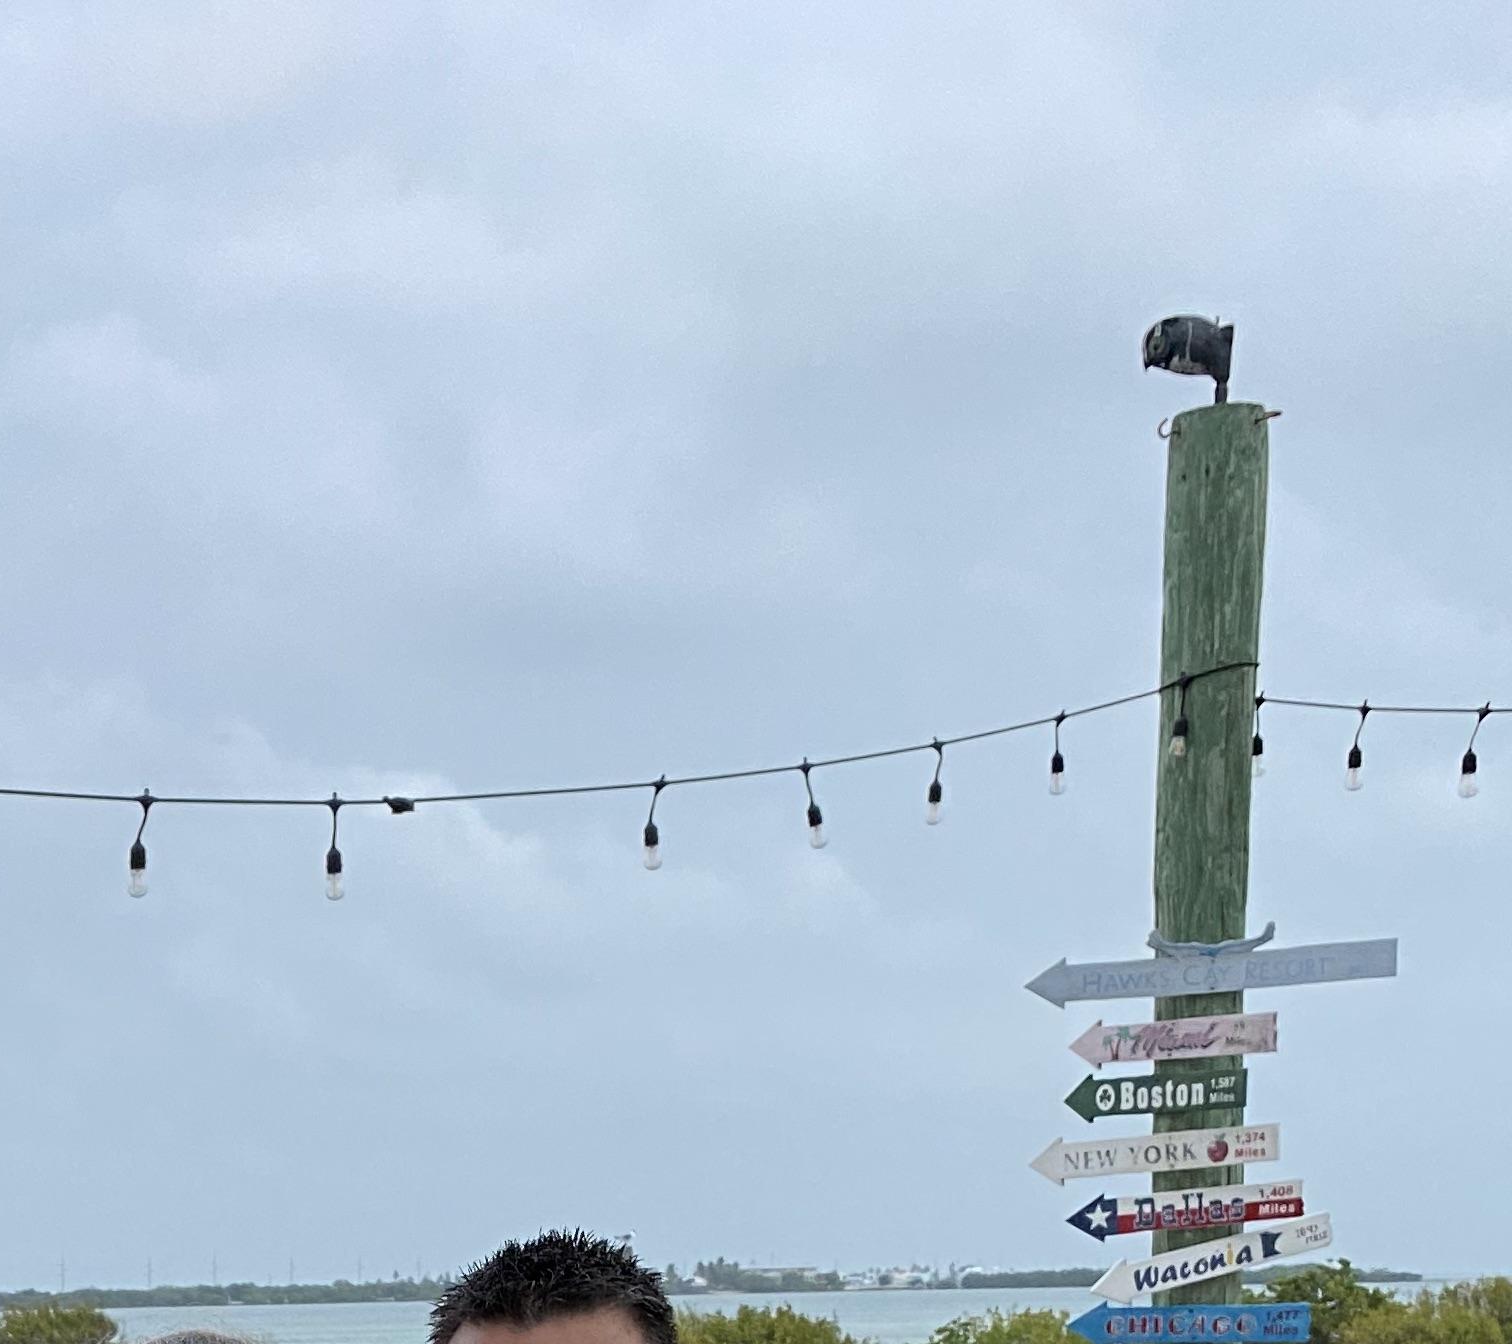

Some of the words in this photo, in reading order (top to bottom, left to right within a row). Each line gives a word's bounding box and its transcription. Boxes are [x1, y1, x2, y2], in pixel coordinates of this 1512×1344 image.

[1082, 970, 1169, 993] HAWKS
[1183, 964, 1231, 986] CAY
[1245, 957, 1336, 981] RESORT
[1119, 1081, 1205, 1111] Boston
[1209, 1091, 1236, 1104] Miles
[1235, 1131, 1266, 1145] 1,374
[1064, 1147, 1118, 1170] NEW
[1128, 1142, 1198, 1166] YORK
[1234, 1147, 1267, 1159] Miles
[1134, 1192, 1246, 1229] Dallas
[1258, 1201, 1296, 1216] Miles
[1133, 1241, 1253, 1292] Waconia
[1104, 1313, 1258, 1337] CHICAGO
[1263, 1325, 1299, 1337] Miles
